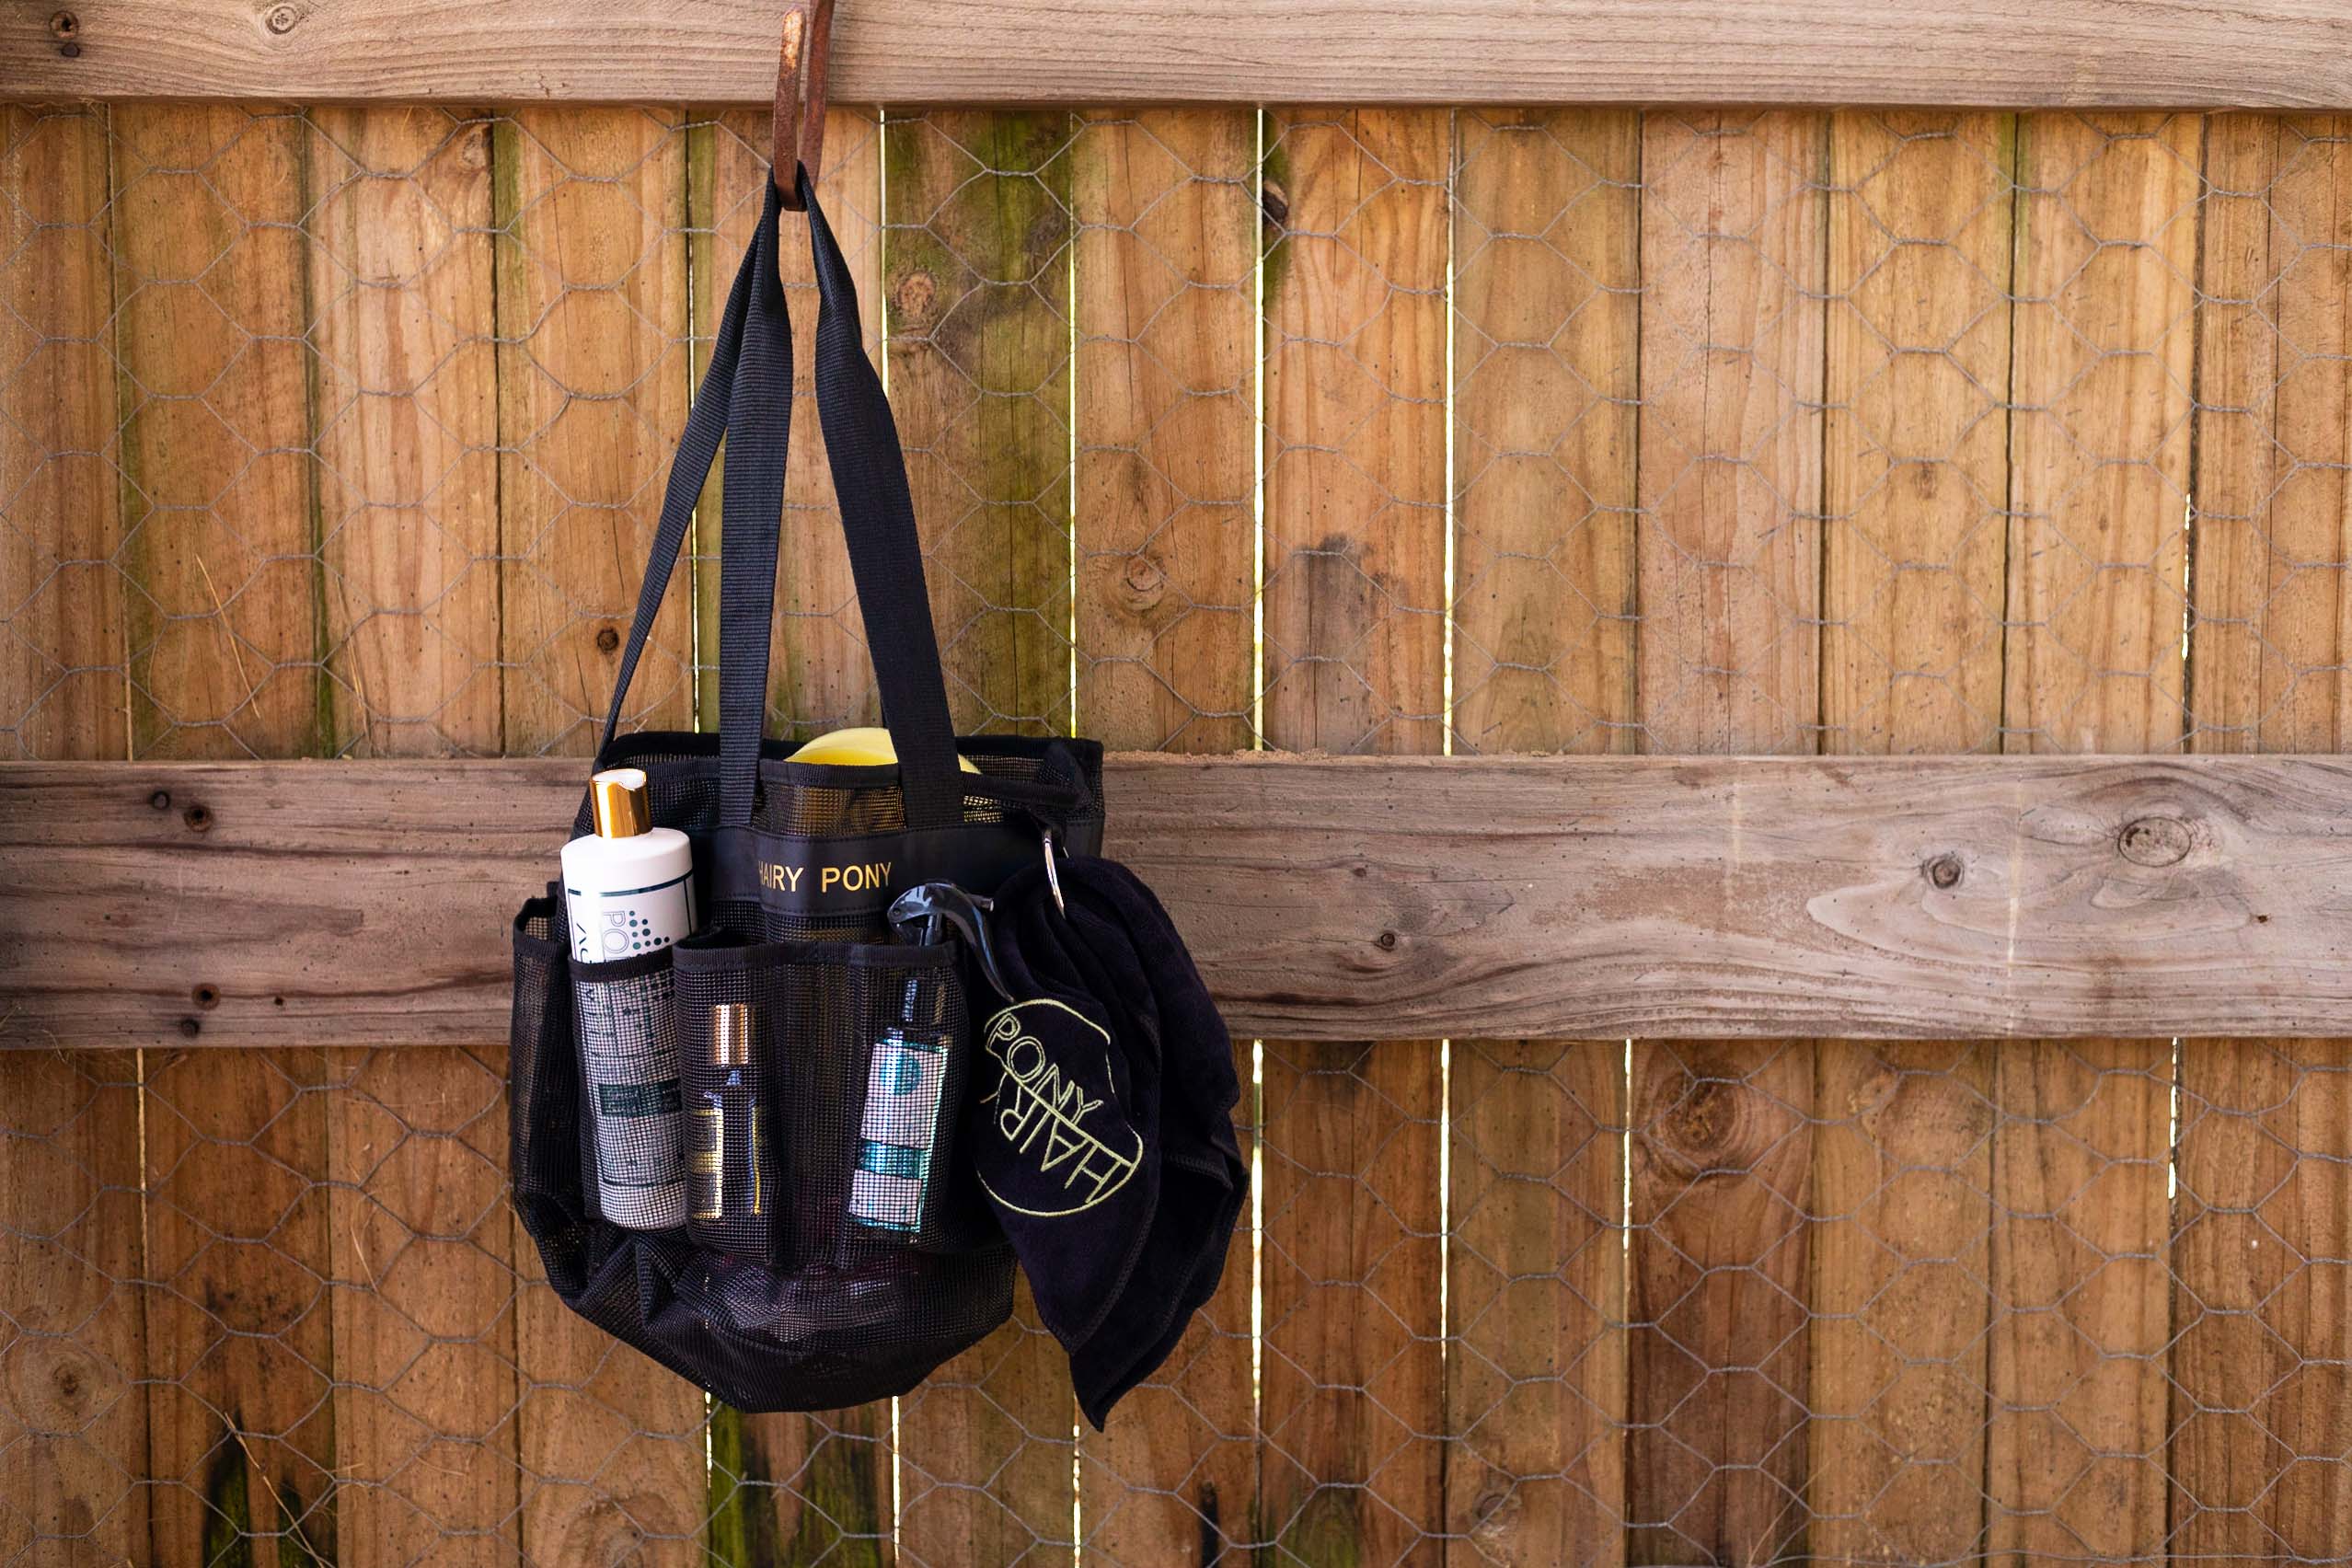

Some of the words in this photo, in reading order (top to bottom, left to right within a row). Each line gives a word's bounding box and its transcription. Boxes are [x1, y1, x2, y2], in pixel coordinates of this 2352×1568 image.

[758, 860, 804, 893] HAIRY
[821, 861, 892, 894] PONY
[986, 1012, 1104, 1125] PONY
